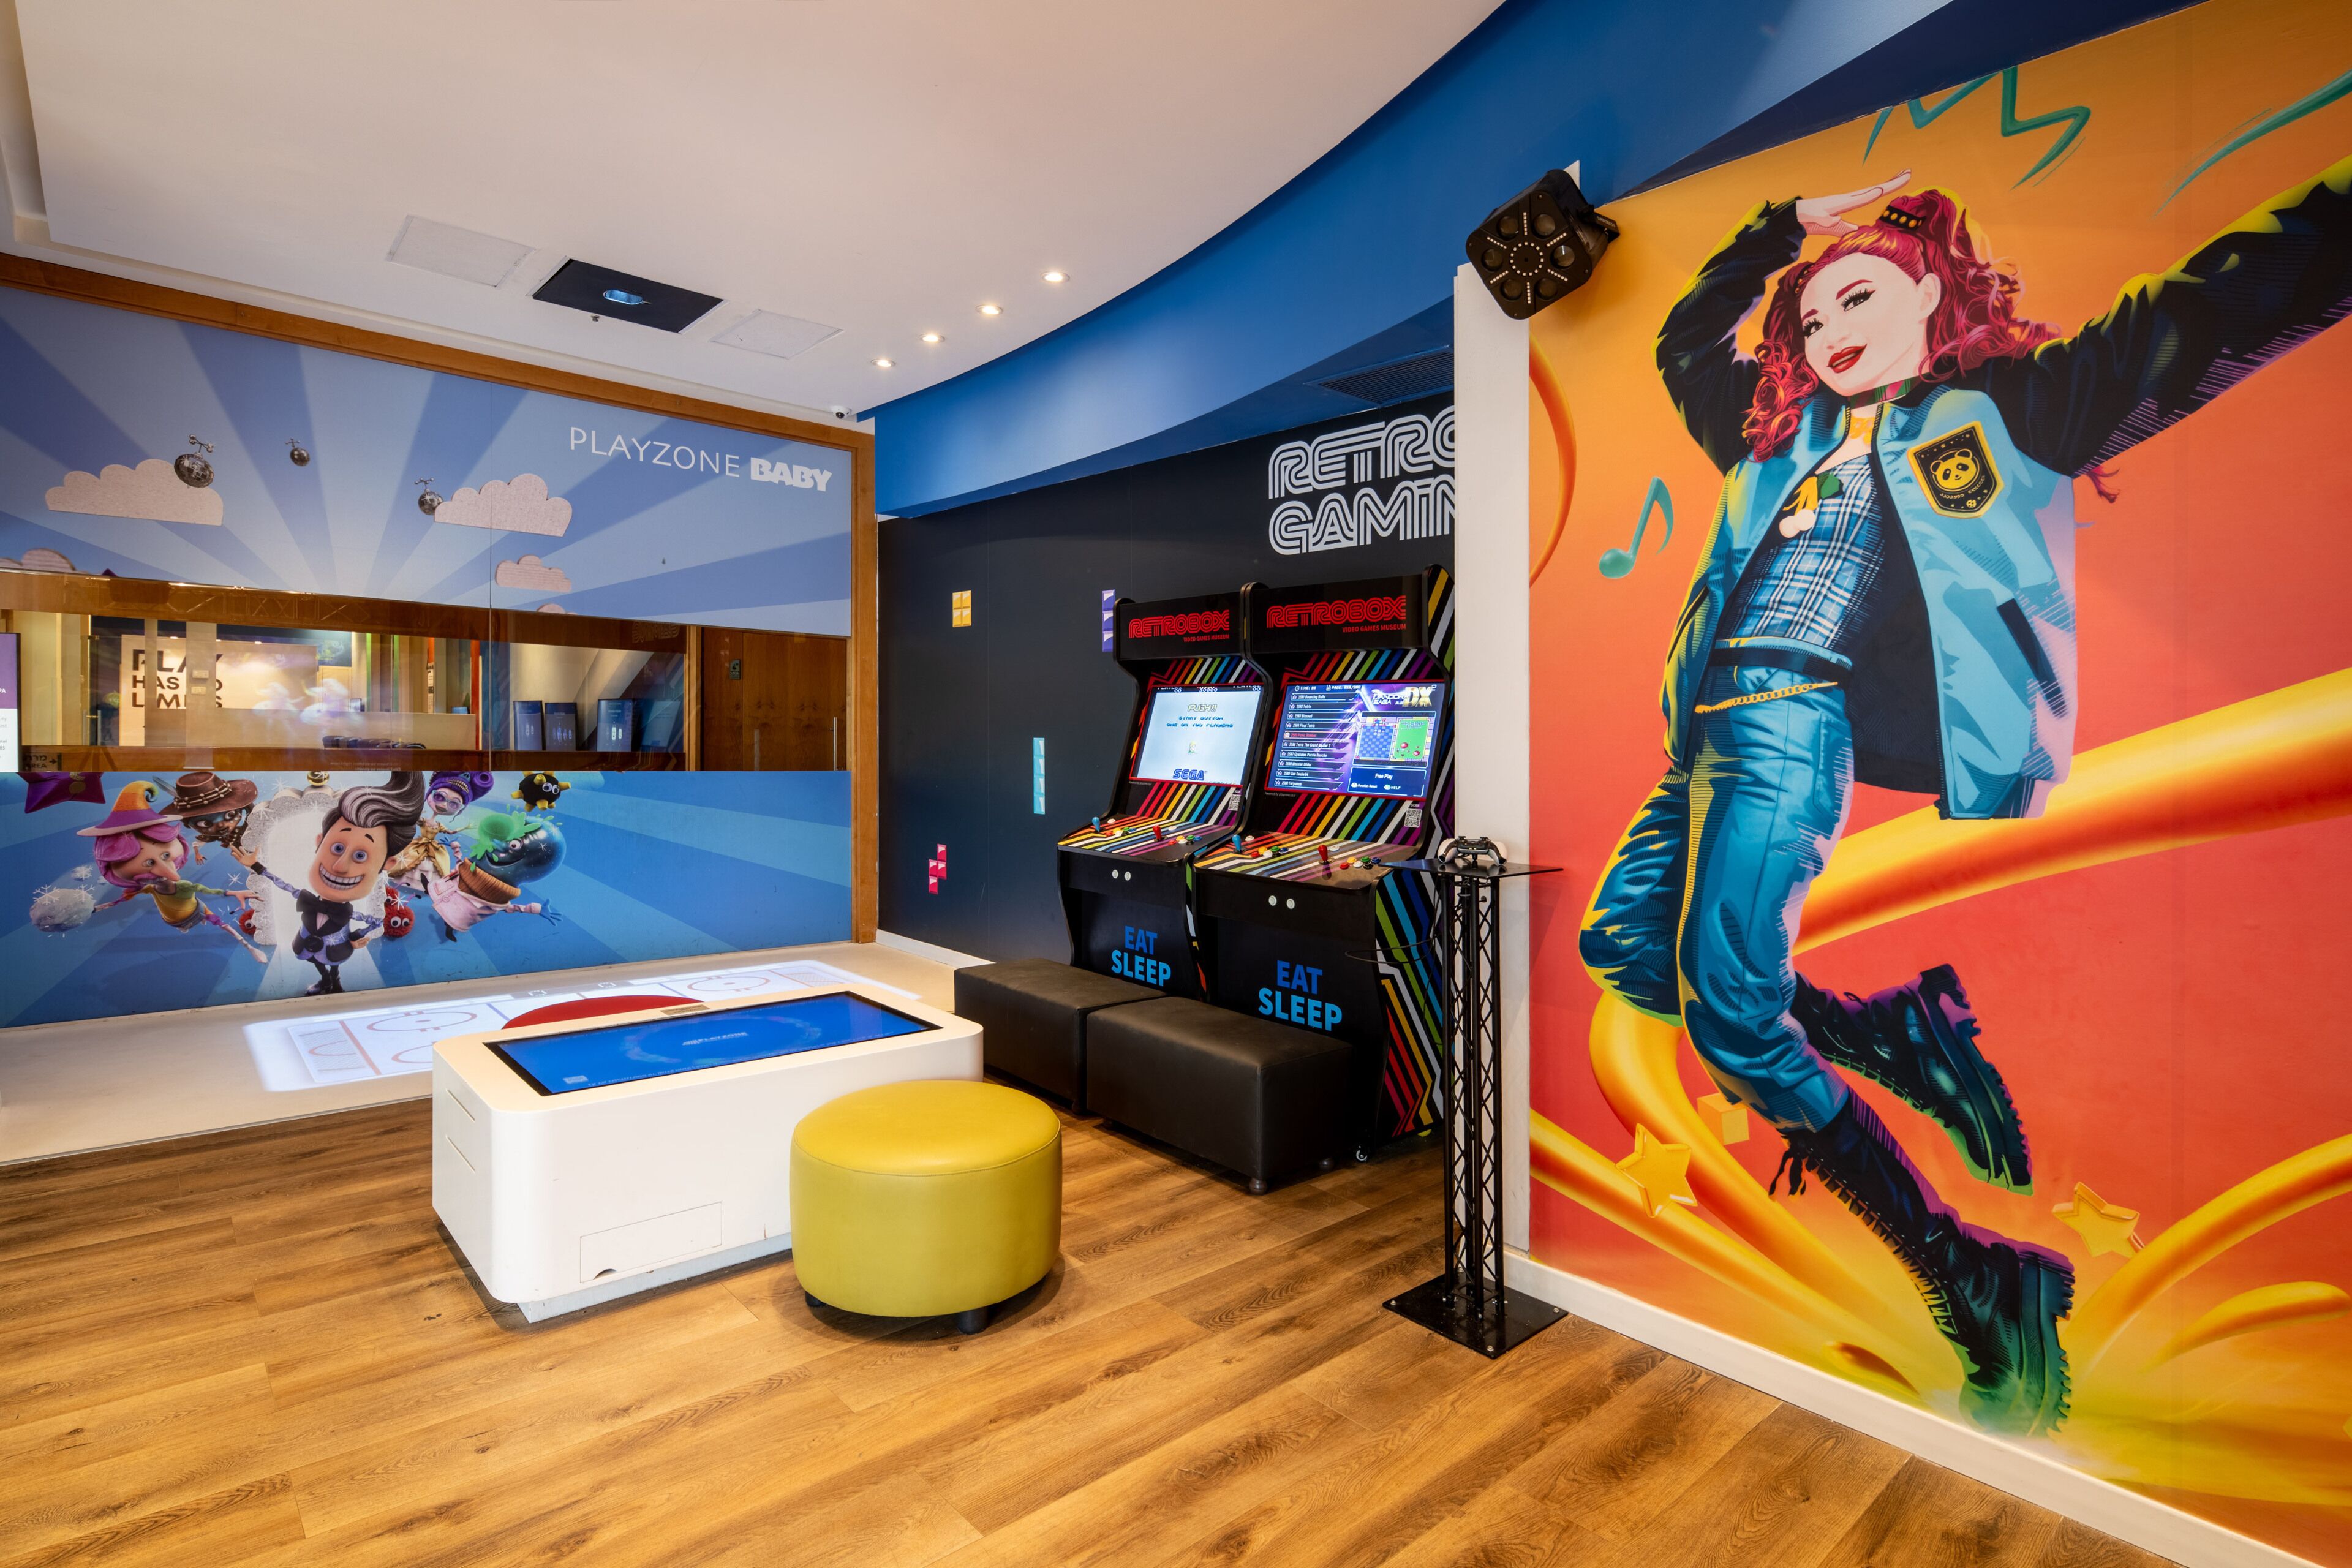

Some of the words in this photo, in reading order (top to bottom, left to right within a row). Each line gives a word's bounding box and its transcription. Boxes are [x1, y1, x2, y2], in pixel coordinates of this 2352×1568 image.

[570, 426, 740, 478] PLAYZONE
[750, 457, 832, 492] BABY
[1129, 610, 1229, 638] RETROBOX
[1267, 595, 1406, 628] RETROBOX
[1402, 687, 1432, 707] DX
[1172, 768, 1204, 781] SEGA
[1125, 925, 1158, 956] EAT
[1111, 949, 1171, 987] SLEEP
[1276, 960, 1322, 995] EAT
[1258, 987, 1343, 1032] SLEEP
